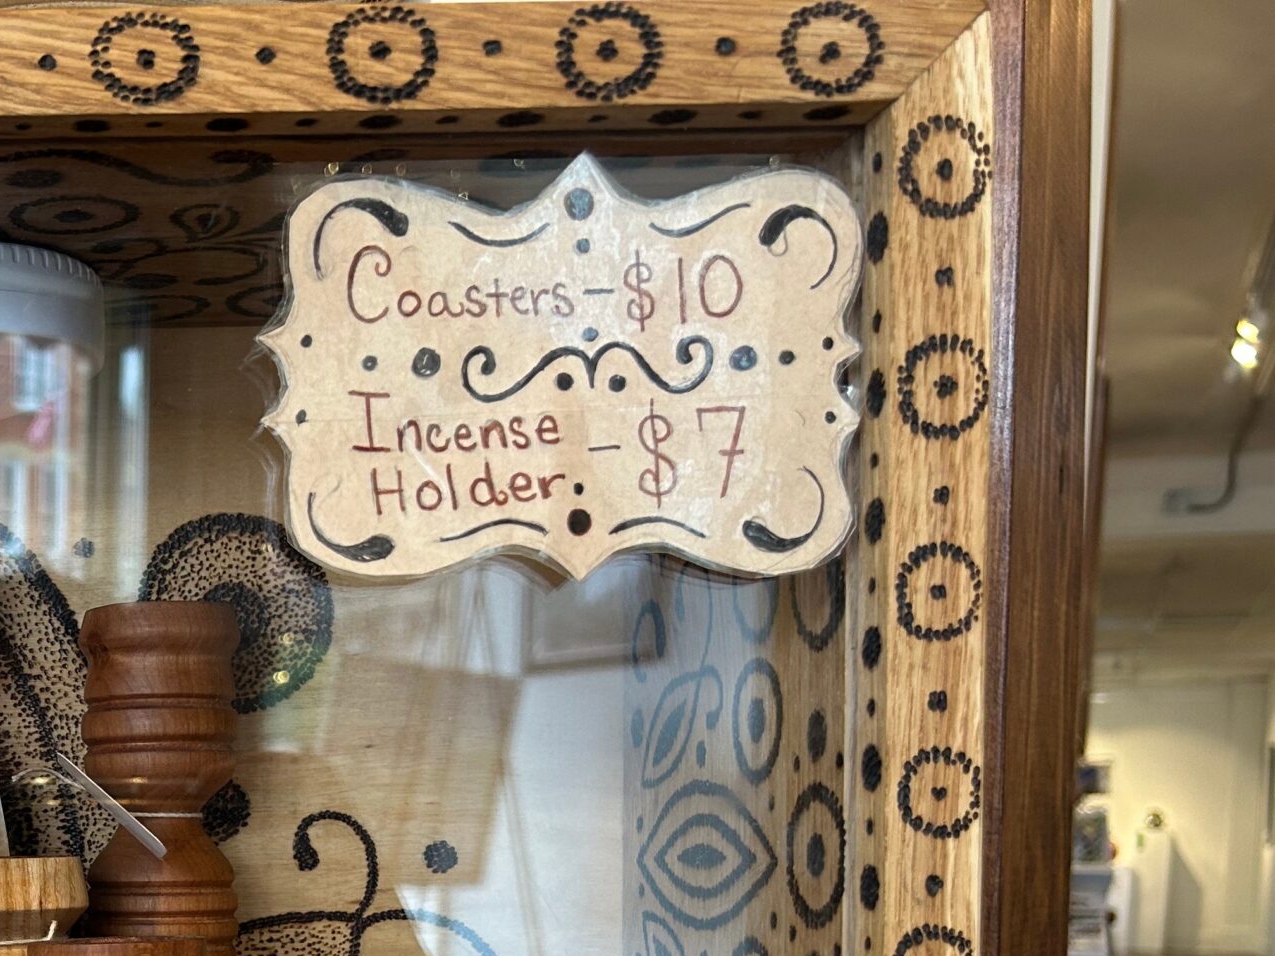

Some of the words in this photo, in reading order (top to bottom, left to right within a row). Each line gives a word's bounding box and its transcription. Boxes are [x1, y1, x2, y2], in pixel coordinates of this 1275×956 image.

[346, 245, 575, 323] Coasters
[347, 389, 562, 453] Incense
[370, 461, 566, 516] Holder
